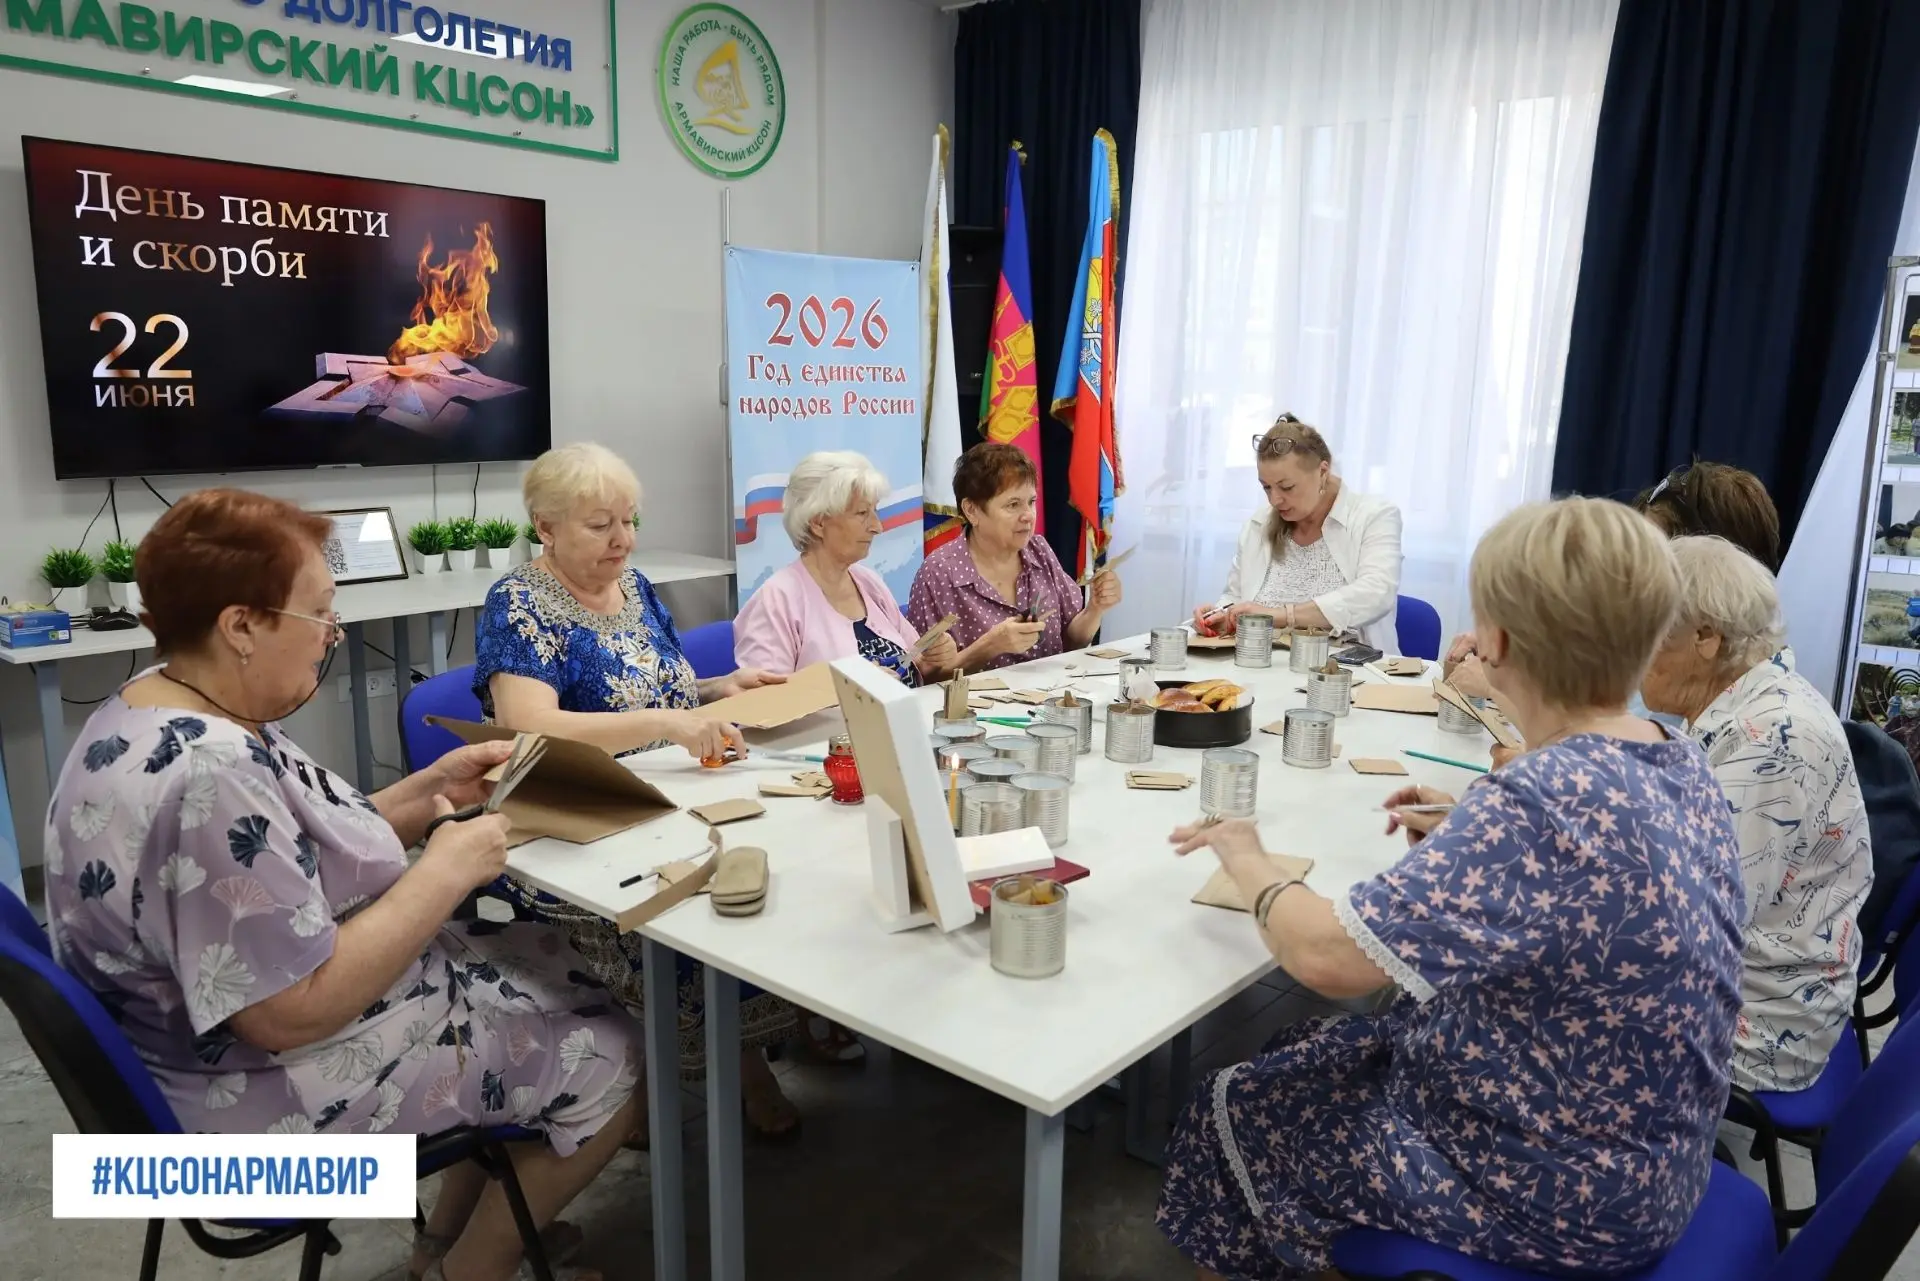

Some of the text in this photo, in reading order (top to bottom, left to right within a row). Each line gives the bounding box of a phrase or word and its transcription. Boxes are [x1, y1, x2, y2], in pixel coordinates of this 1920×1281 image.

[7, 0, 595, 127] МАВИРСКИЙ КЦСОН»
[672, 45, 686, 86] НАША
[682, 20, 721, 44] РАБОТА
[729, 24, 757, 55] БЫТЬ
[757, 56, 775, 106] РЯДОМ
[675, 101, 772, 162] АРМАВИРСКИЙ КЦСОН
[75, 169, 390, 238] День памяти
[81, 236, 307, 286] и скорби
[90, 311, 193, 379] 22
[765, 292, 889, 350] 2026
[747, 354, 906, 386] Год единства
[740, 391, 915, 422] народов России
